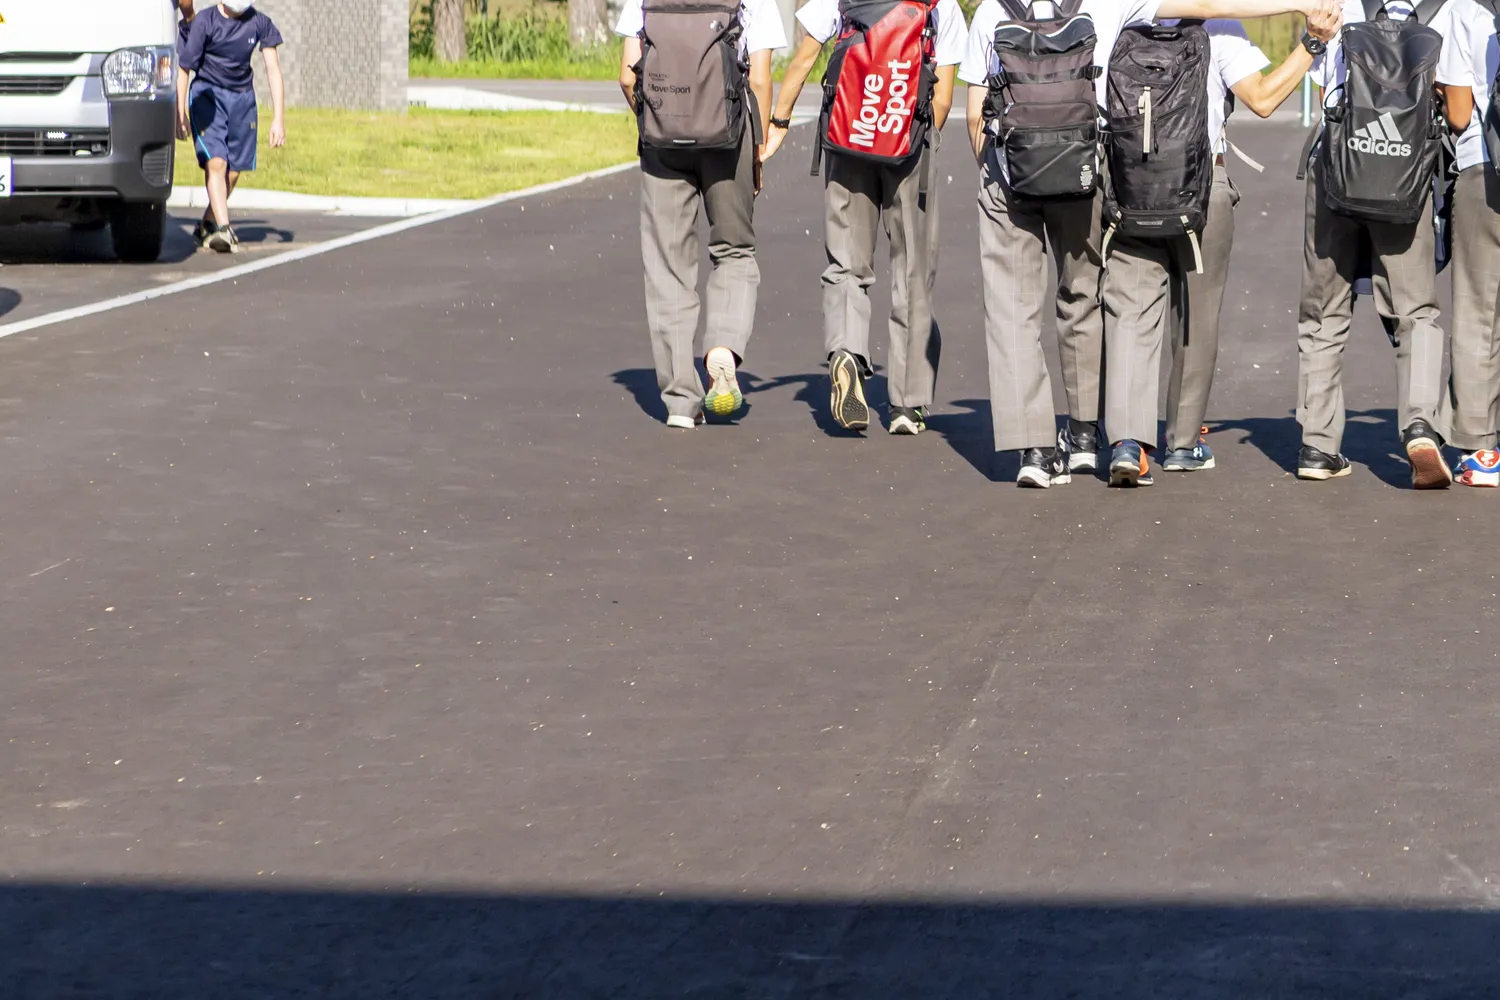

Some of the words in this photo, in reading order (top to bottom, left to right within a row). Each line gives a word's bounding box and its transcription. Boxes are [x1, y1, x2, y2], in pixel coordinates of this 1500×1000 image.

[648, 83, 669, 93] Move
[670, 85, 691, 95] Sport
[849, 74, 884, 148] Move
[877, 59, 911, 135] Sport
[1347, 136, 1412, 157] adidas
